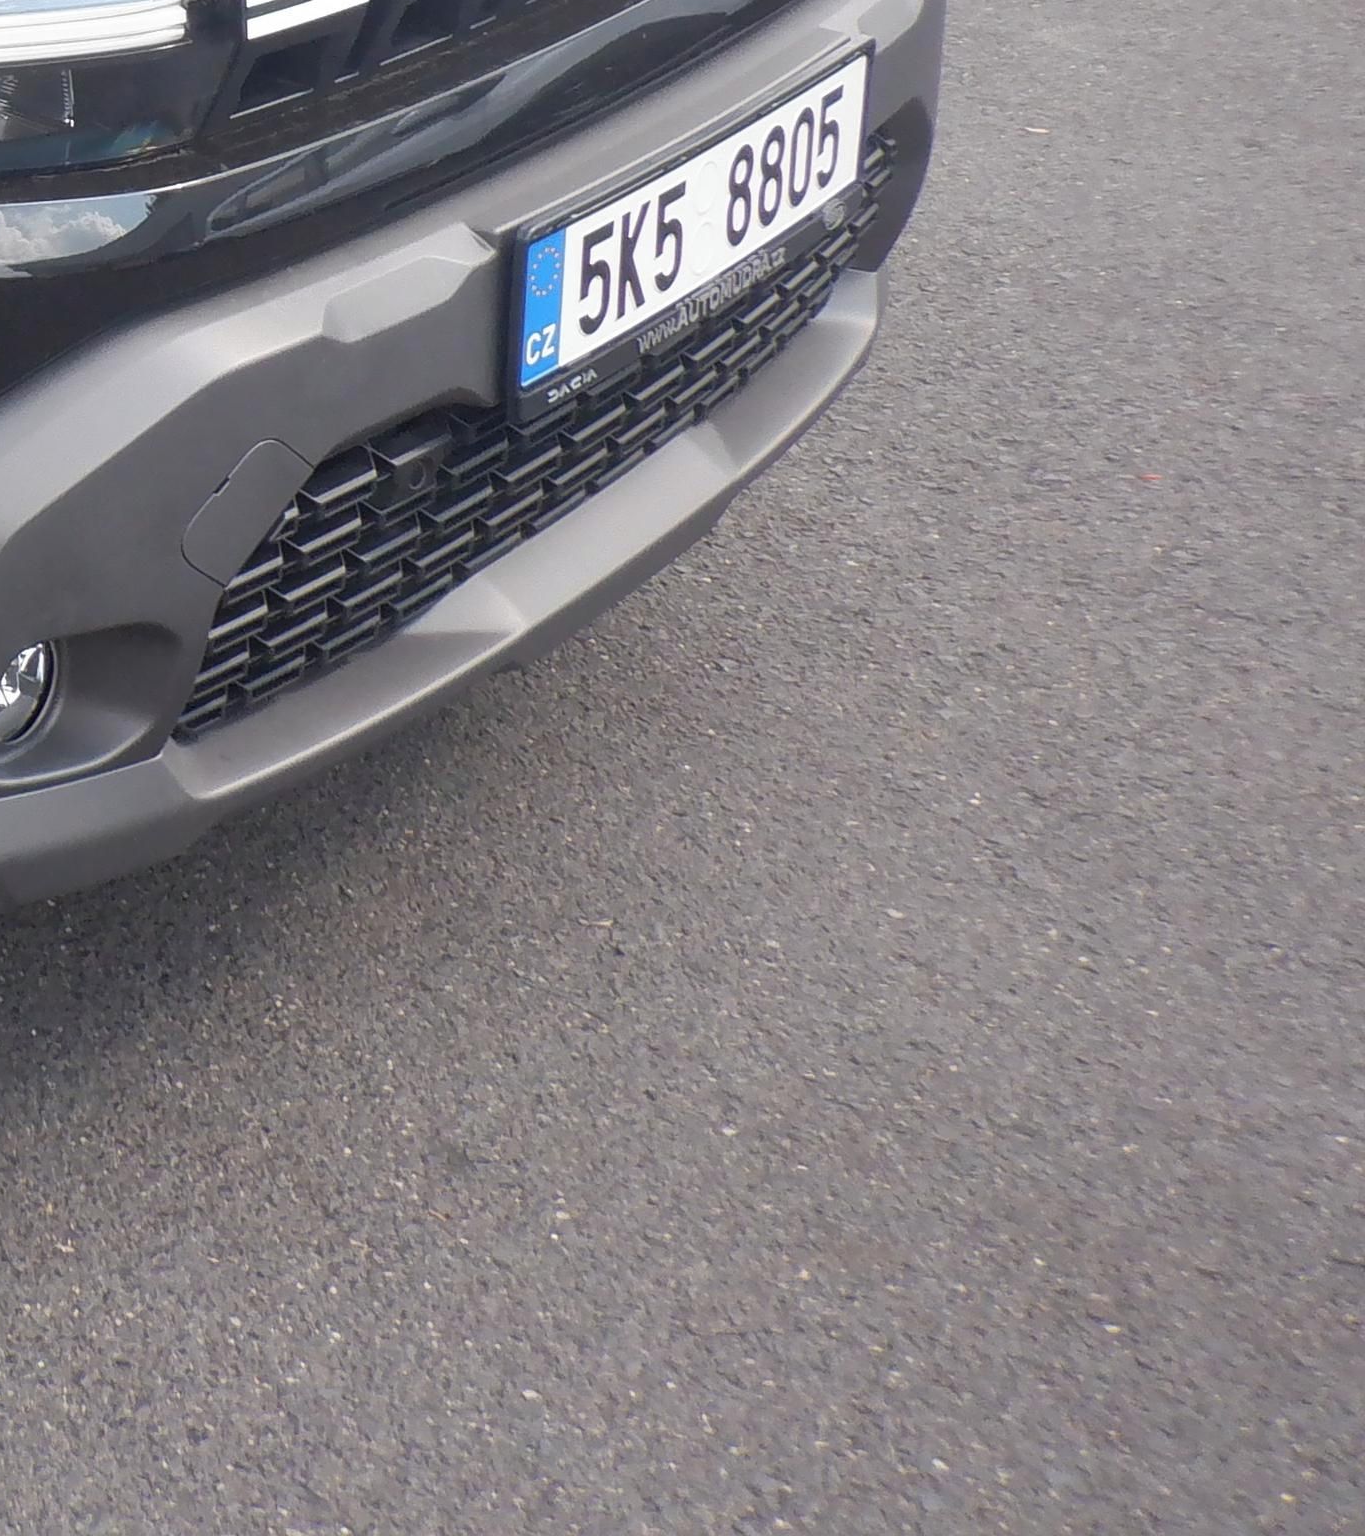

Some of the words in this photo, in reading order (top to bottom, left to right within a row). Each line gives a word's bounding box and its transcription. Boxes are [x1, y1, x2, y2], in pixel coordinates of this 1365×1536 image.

[578, 179, 687, 336] 5K5
[725, 84, 845, 247] 8805
[525, 323, 557, 366] CZ
